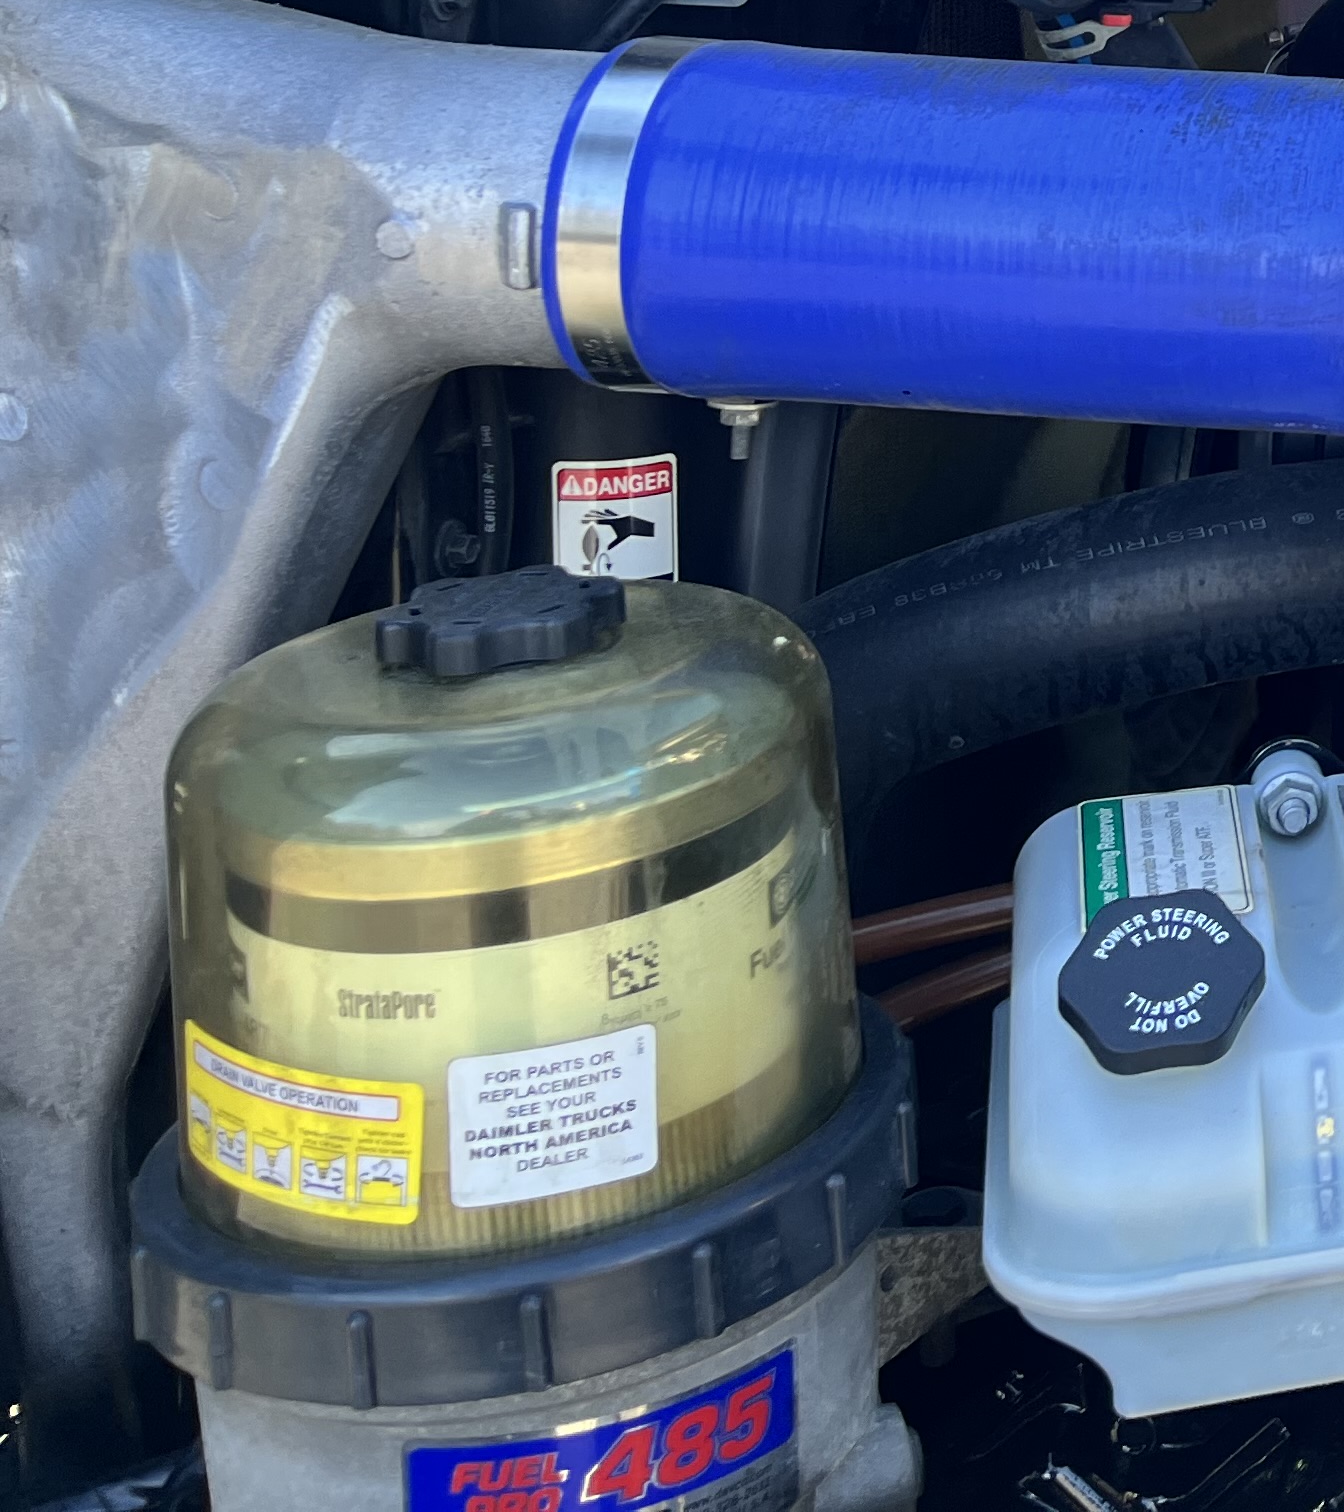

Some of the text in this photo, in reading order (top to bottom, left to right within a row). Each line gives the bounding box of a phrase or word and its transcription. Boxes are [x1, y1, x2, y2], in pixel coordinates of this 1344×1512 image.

[584, 470, 670, 495] DANGER
[1076, 516, 1268, 562] BLUESTRIPE
[1095, 807, 1121, 890] Steering Reservoir
[1093, 907, 1230, 960] POWER STEERING
[1130, 924, 1192, 948] FLUID
[1124, 981, 1210, 1016] OVERFILL
[1129, 1008, 1201, 1033] DO NOT
[478, 1067, 622, 1104] REPLACEMENTS
[484, 1050, 615, 1085] FOR PARTS OR
[210, 1059, 358, 1113] DRAIN VALVE OPERATION
[464, 1099, 637, 1143] DAIMLER TRUCKS
[506, 1092, 596, 1119] SEE YOUR
[469, 1120, 632, 1160] NORTH AMERICA
[517, 1147, 589, 1173] DEALER
[451, 1452, 567, 1494] FUEL
[581, 1368, 777, 1504] 485
[464, 1488, 563, 1512] PRO
